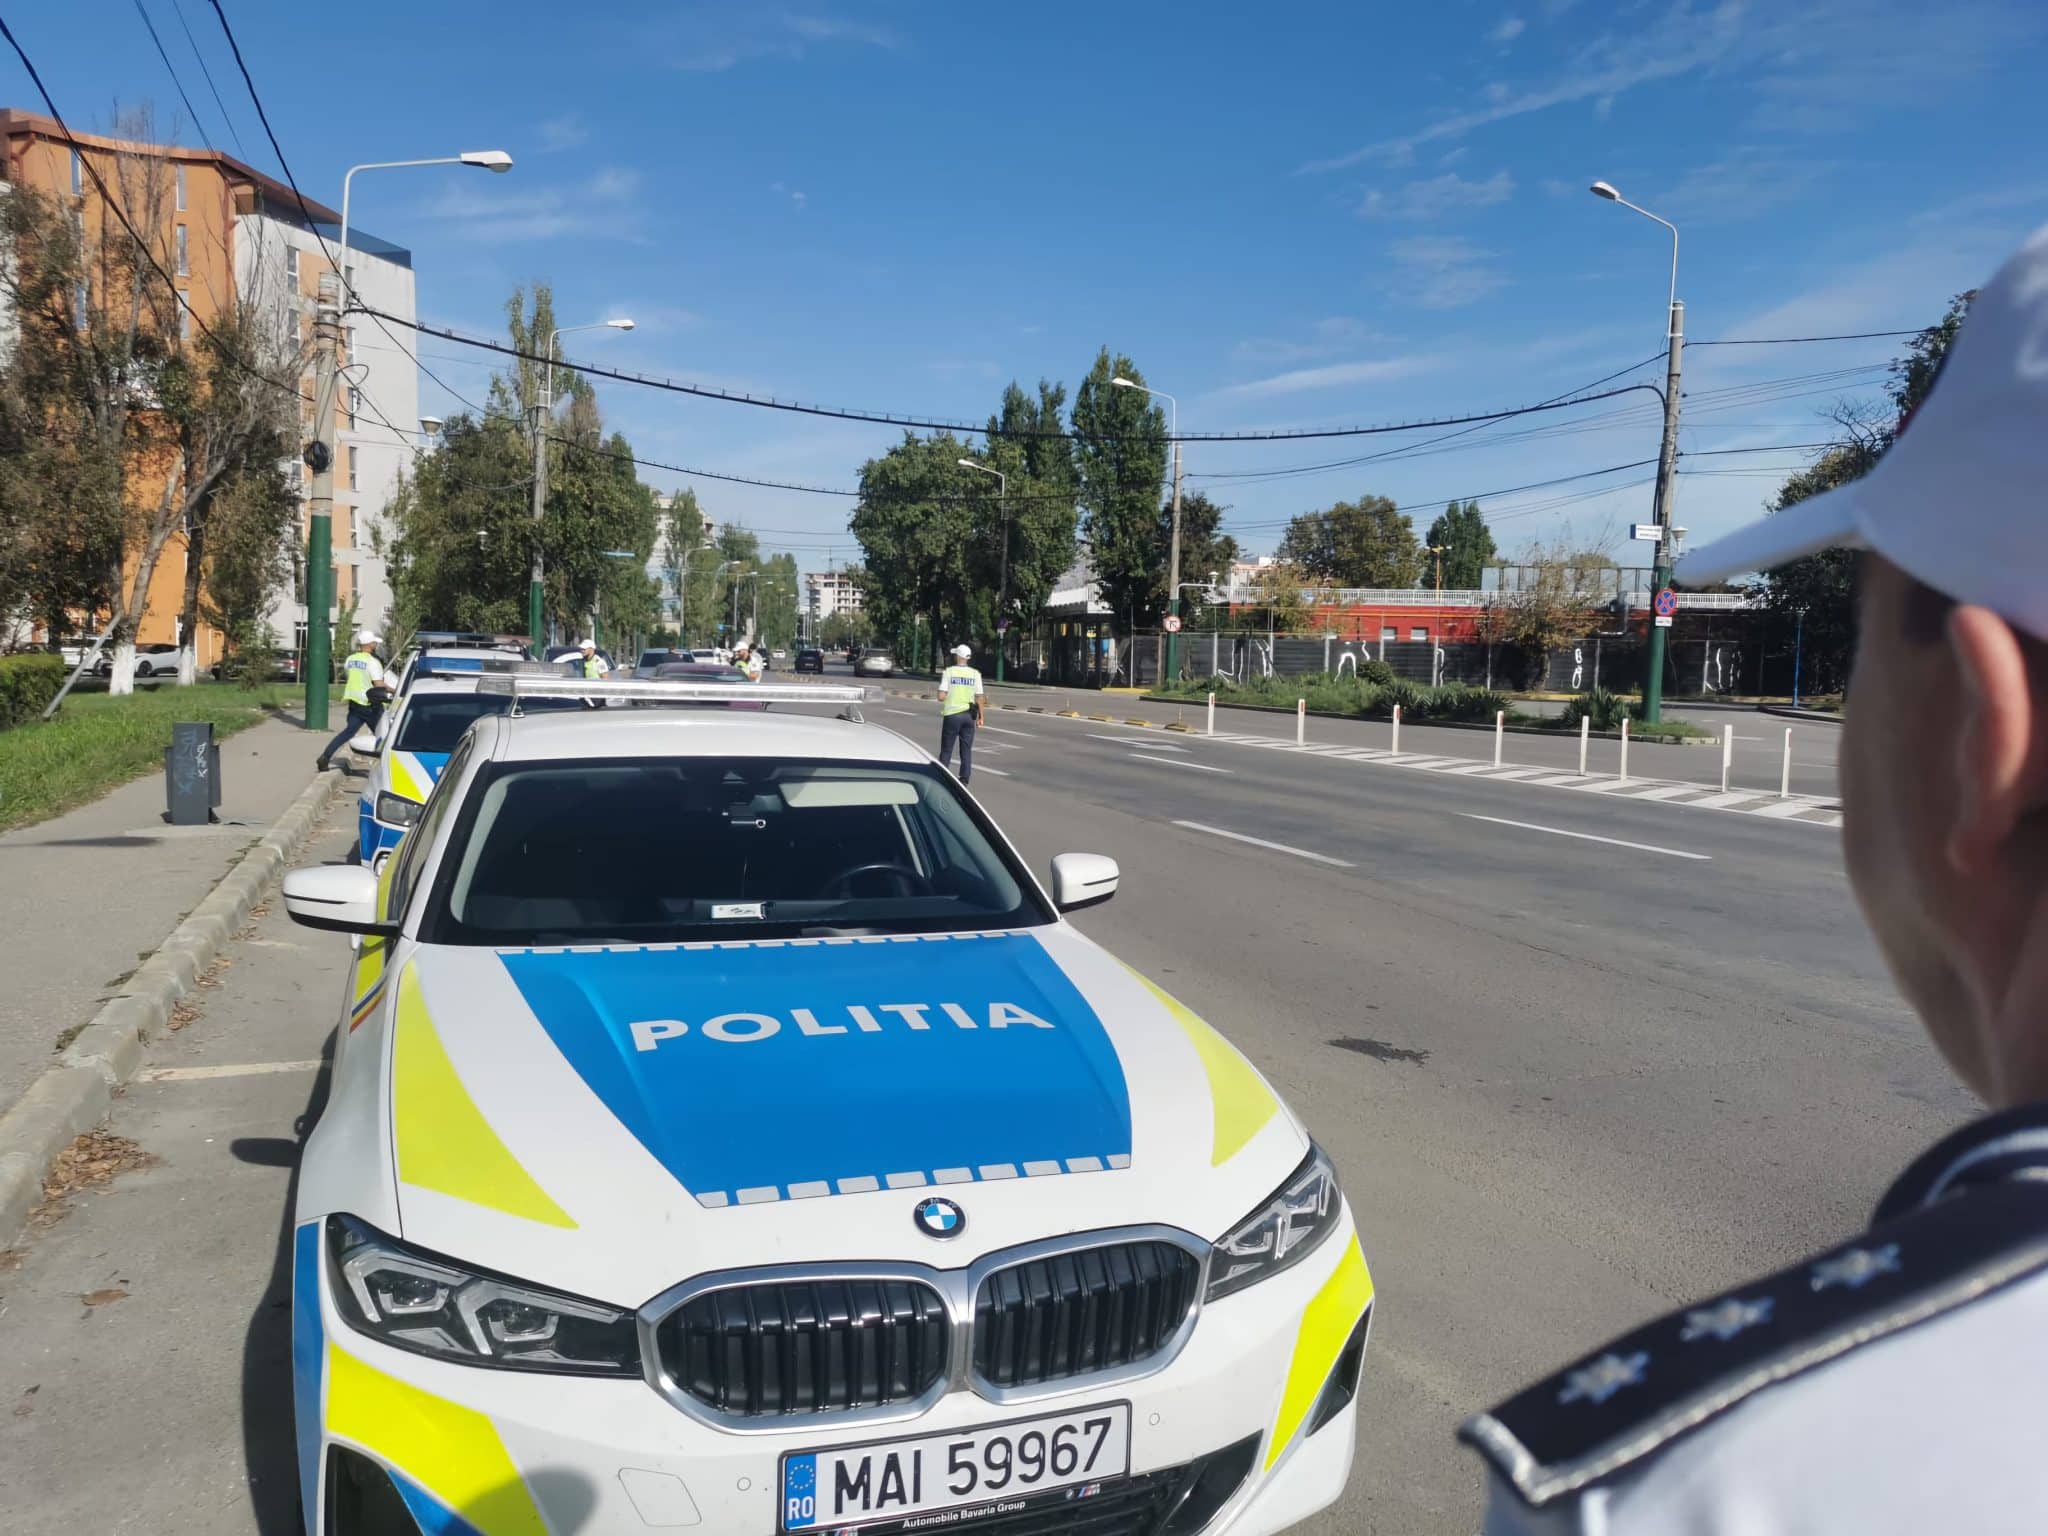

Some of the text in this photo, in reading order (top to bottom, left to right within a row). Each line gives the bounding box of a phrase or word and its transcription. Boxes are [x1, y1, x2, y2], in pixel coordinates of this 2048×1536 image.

[629, 1002, 1056, 1052] POLITIA
[834, 1417, 1112, 1515] MAI 59967
[787, 1496, 814, 1521] RO
[902, 1500, 1026, 1529] Automobile Bavaria Group
